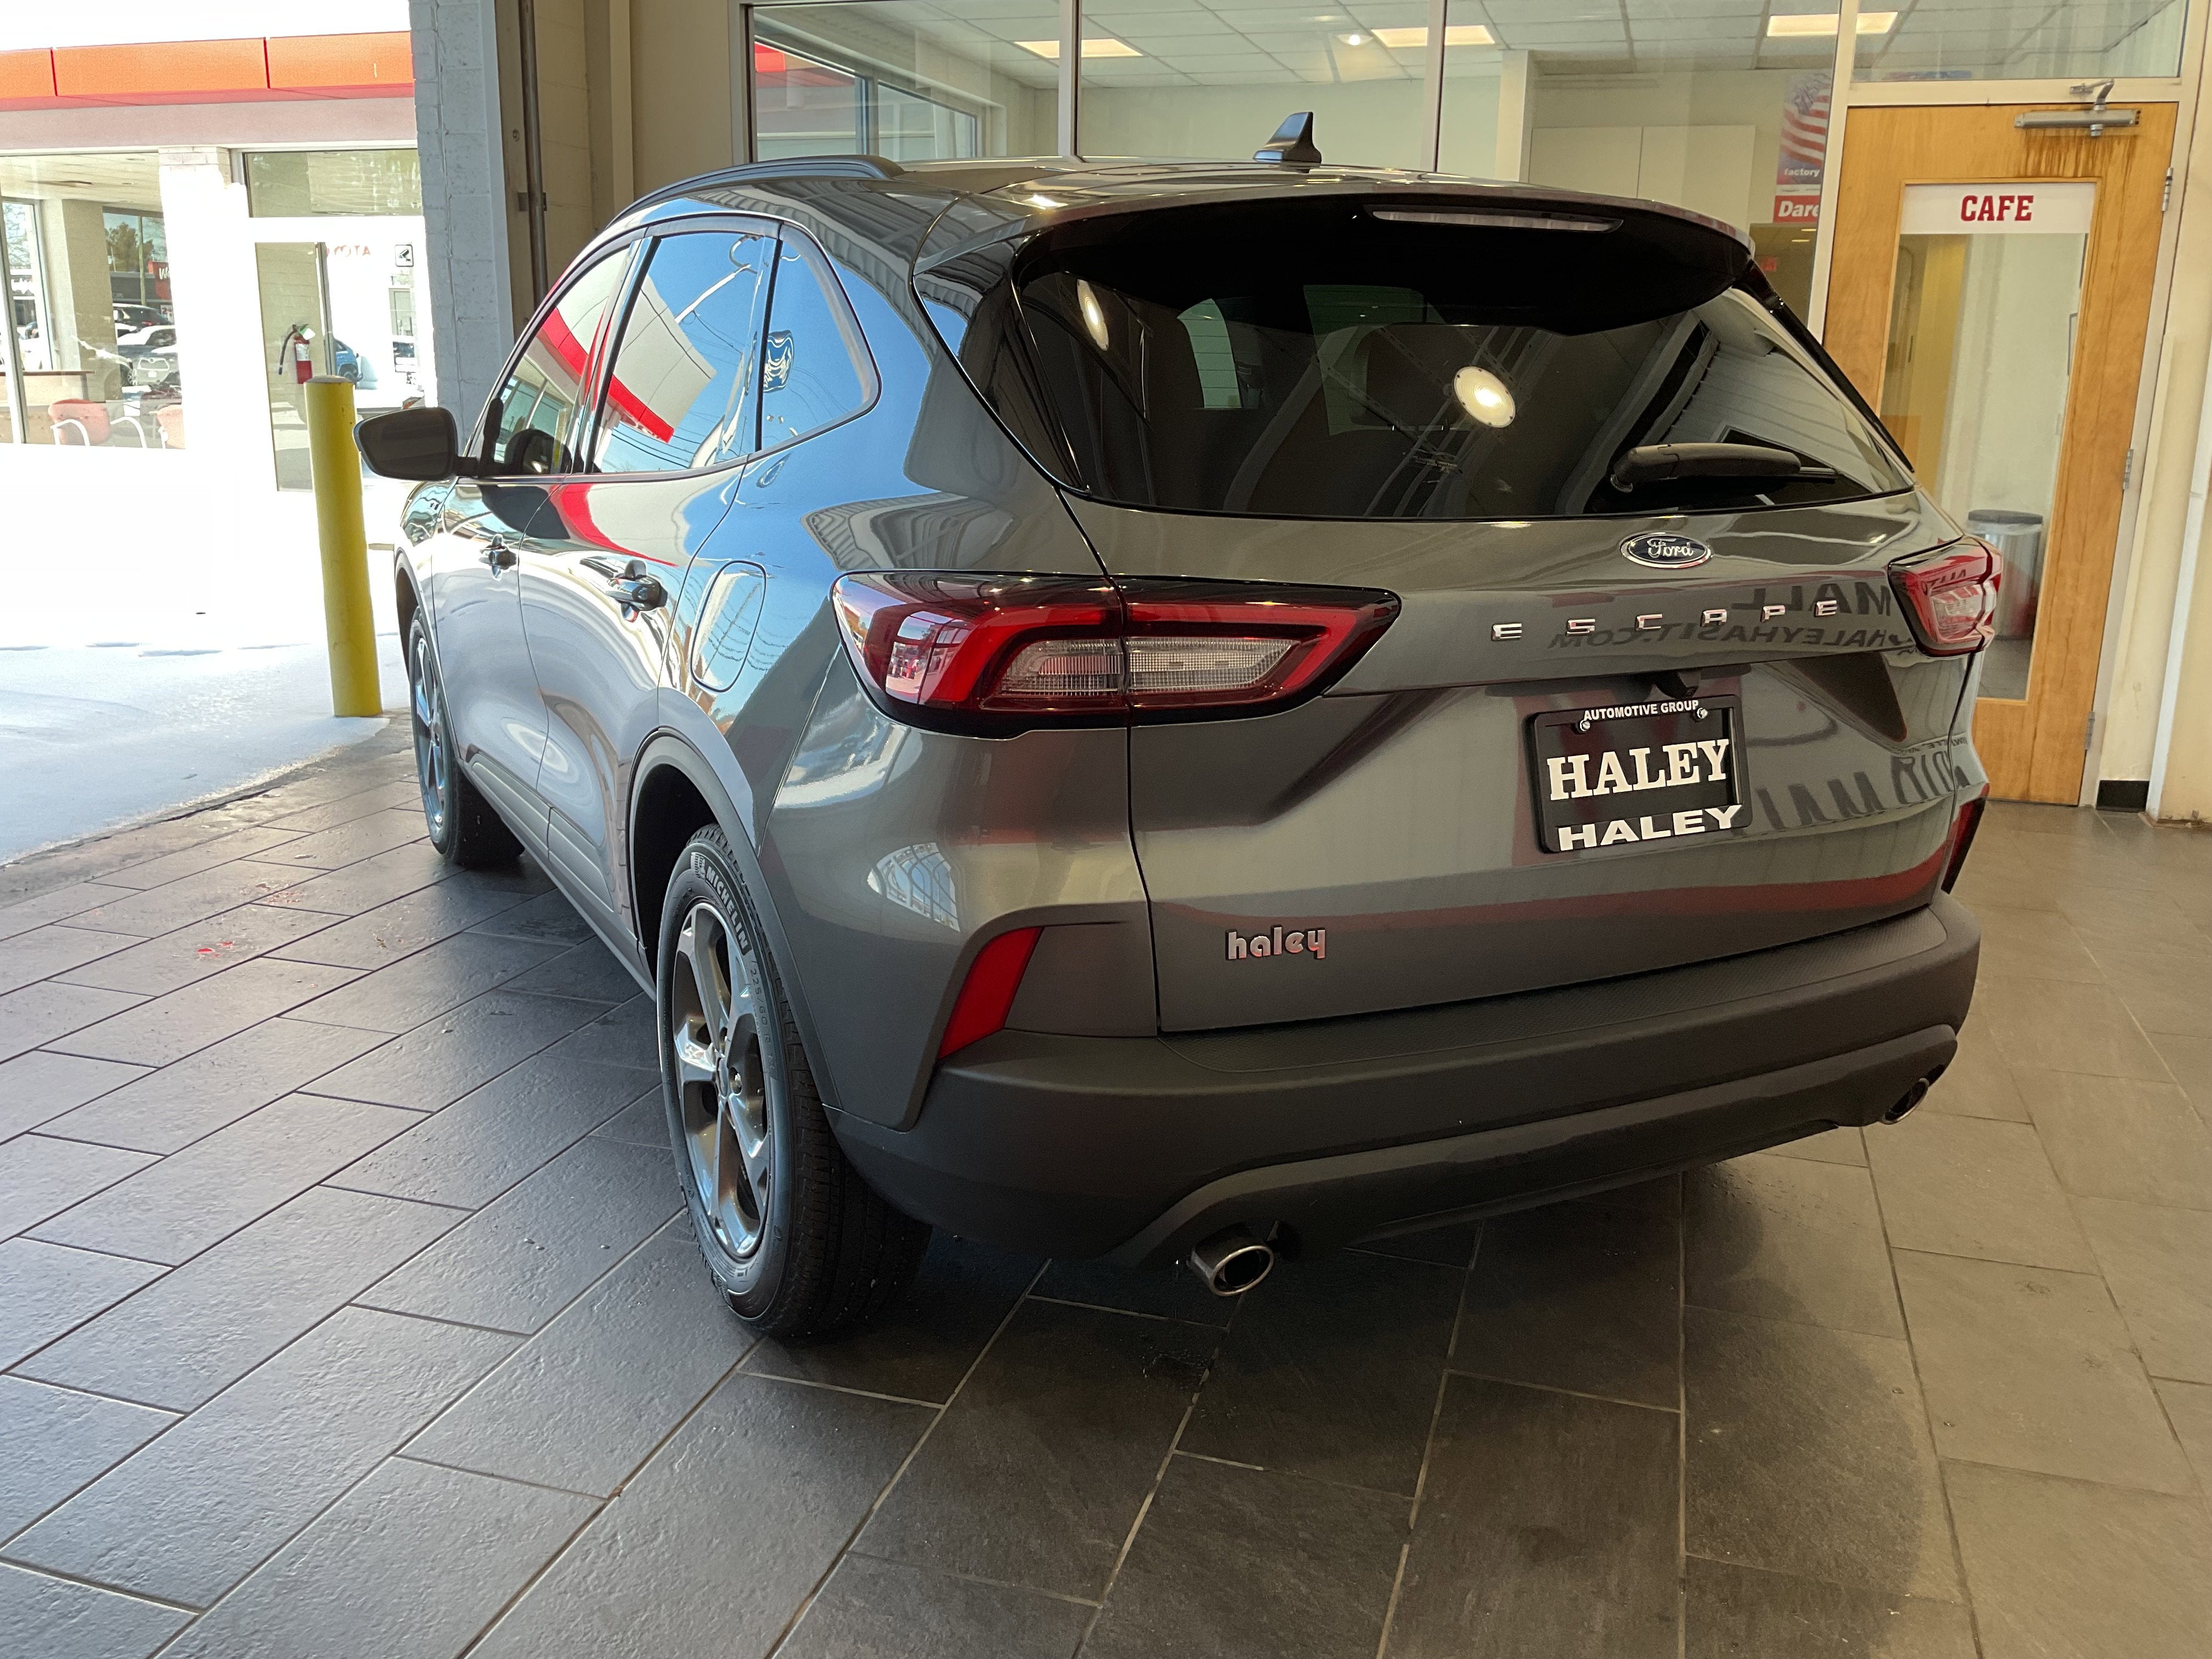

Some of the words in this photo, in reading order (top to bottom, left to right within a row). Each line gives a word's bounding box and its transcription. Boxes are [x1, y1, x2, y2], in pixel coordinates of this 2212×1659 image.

[1960, 195, 2034, 222] CAFE
[1646, 538, 1694, 558] Ford
[1491, 599, 1838, 641] ESCAPE
[1583, 704, 1658, 721] AUTOMOTIVE
[1661, 699, 1699, 714] GROUP
[1547, 738, 1729, 801] HALEY
[1558, 804, 1742, 851] HALEY
[705, 865, 749, 950] MICHELIN
[1226, 924, 1326, 960] haley
